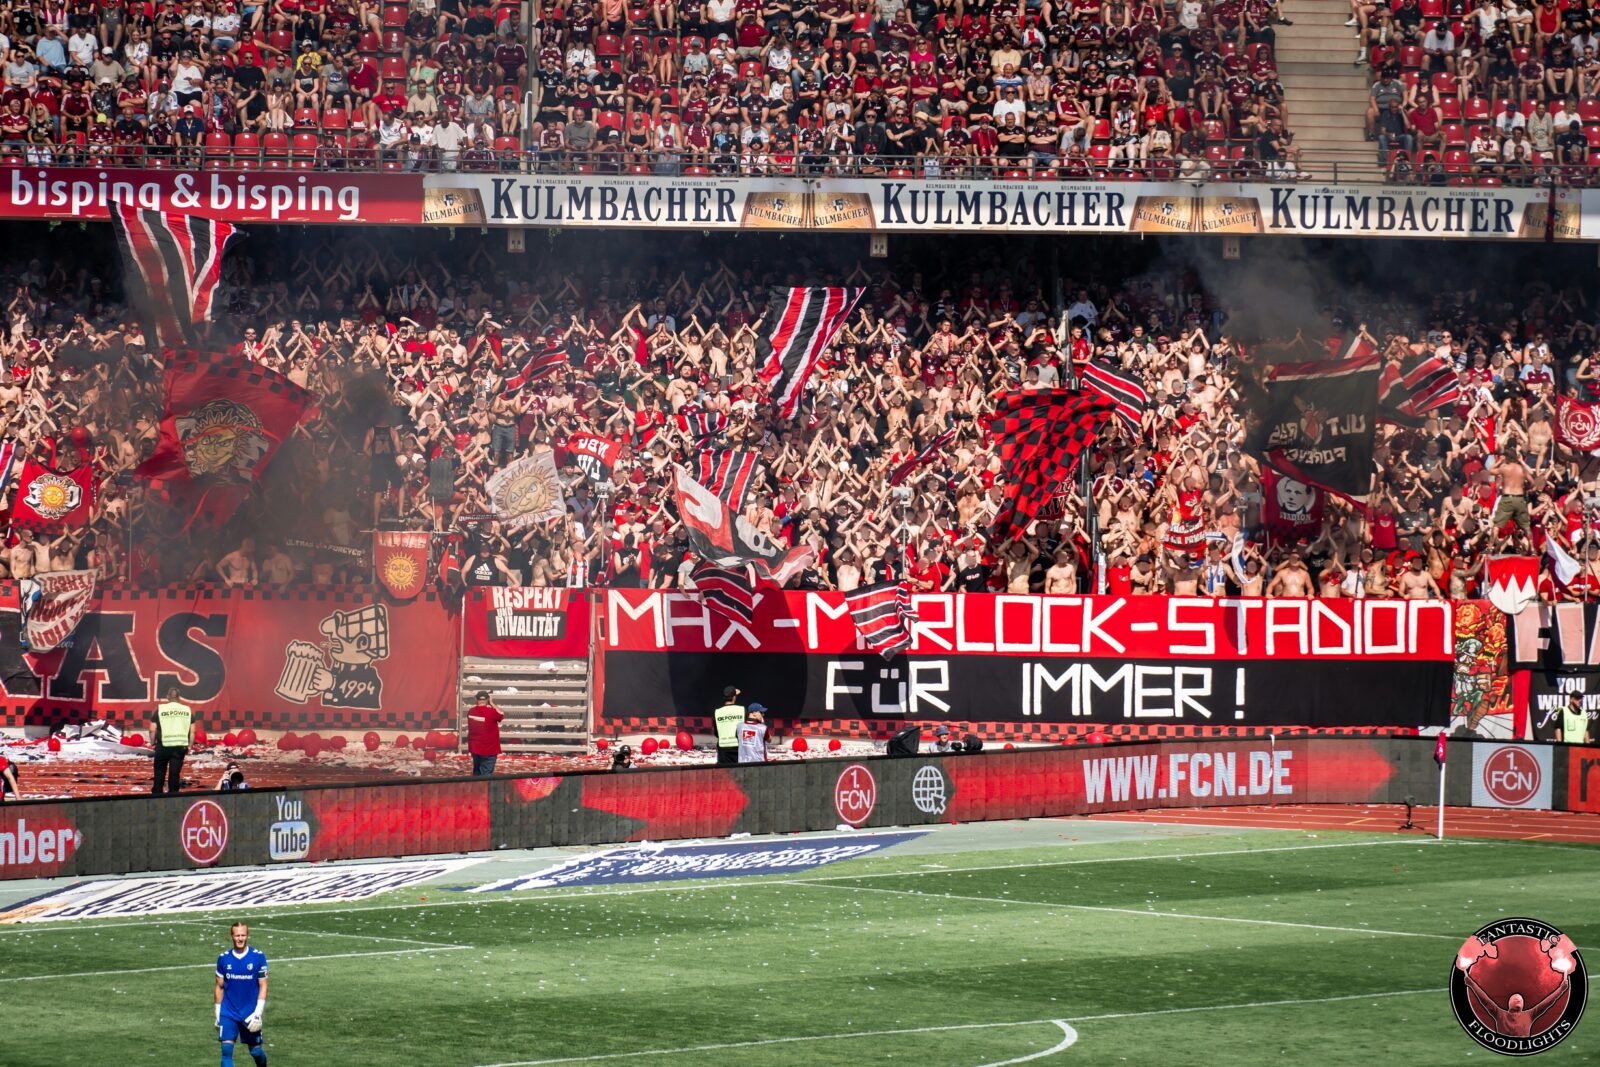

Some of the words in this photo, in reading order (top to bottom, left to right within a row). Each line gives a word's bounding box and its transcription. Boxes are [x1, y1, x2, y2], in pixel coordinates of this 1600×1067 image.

[11, 169, 160, 215] bisping
[170, 173, 202, 208] &
[211, 173, 359, 221] bisping
[491, 178, 737, 222] KULMBACHER
[881, 183, 1126, 227] KULMBACHER
[423, 202, 479, 222] KULMBACHER
[748, 205, 803, 226] KULMBACHER
[813, 207, 869, 227] KULMBACHER
[1136, 208, 1192, 230] KULMBACHER
[1270, 188, 1515, 232] KULMBACHER
[1570, 421, 1590, 432] FCN
[379, 533, 428, 549] ULTRAS
[492, 586, 564, 609] RESPEKT
[496, 606, 513, 617] UND
[607, 588, 1453, 656] MAX-MRLOCK-STADION
[495, 612, 561, 637] RIVALITÄT
[338, 679, 376, 699] 1994
[825, 660, 951, 714] FÜR
[1022, 662, 1213, 718] IMMER
[1555, 677, 1587, 694] YOU
[1506, 751, 1519, 771] 1.
[1083, 750, 1293, 804] WWW.FCN.DE
[1491, 770, 1533, 791] FCN
[276, 795, 302, 821] You
[840, 788, 871, 811] FCN
[186, 826, 223, 850] FCN
[272, 825, 307, 854] Tube
